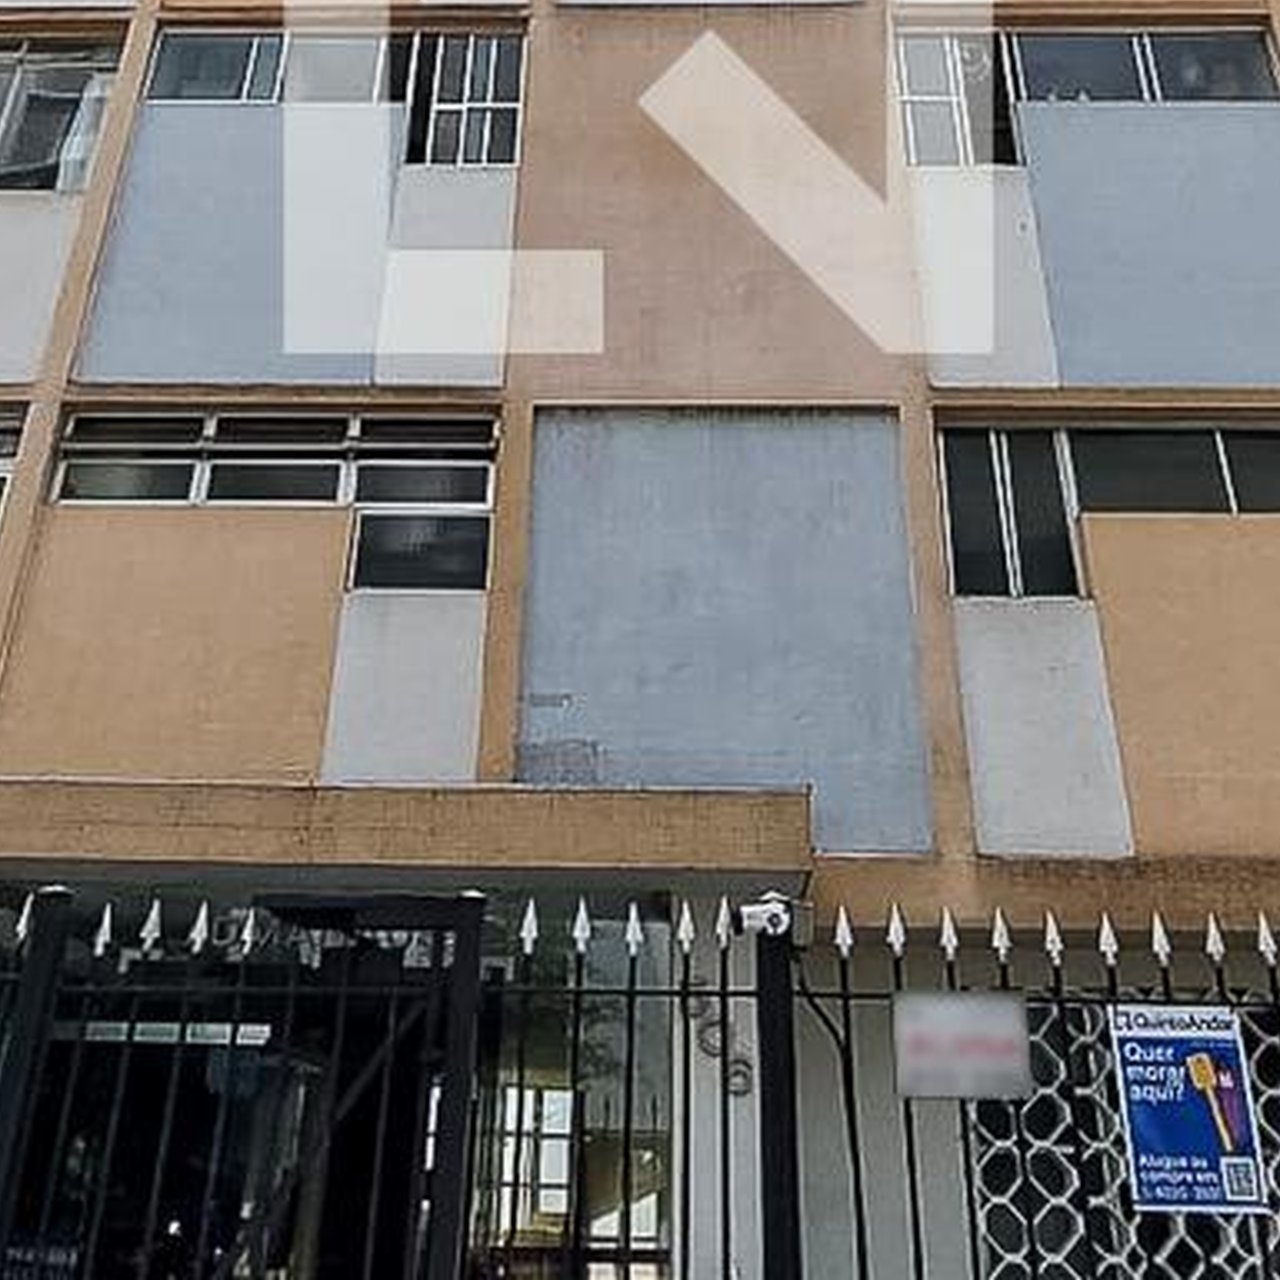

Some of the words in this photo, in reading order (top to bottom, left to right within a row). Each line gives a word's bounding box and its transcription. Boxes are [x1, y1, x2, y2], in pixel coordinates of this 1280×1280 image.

[1124, 1041, 1175, 1062] Quer
[1126, 1065, 1185, 1082] morar
[1129, 1082, 1185, 1105] aqui?
